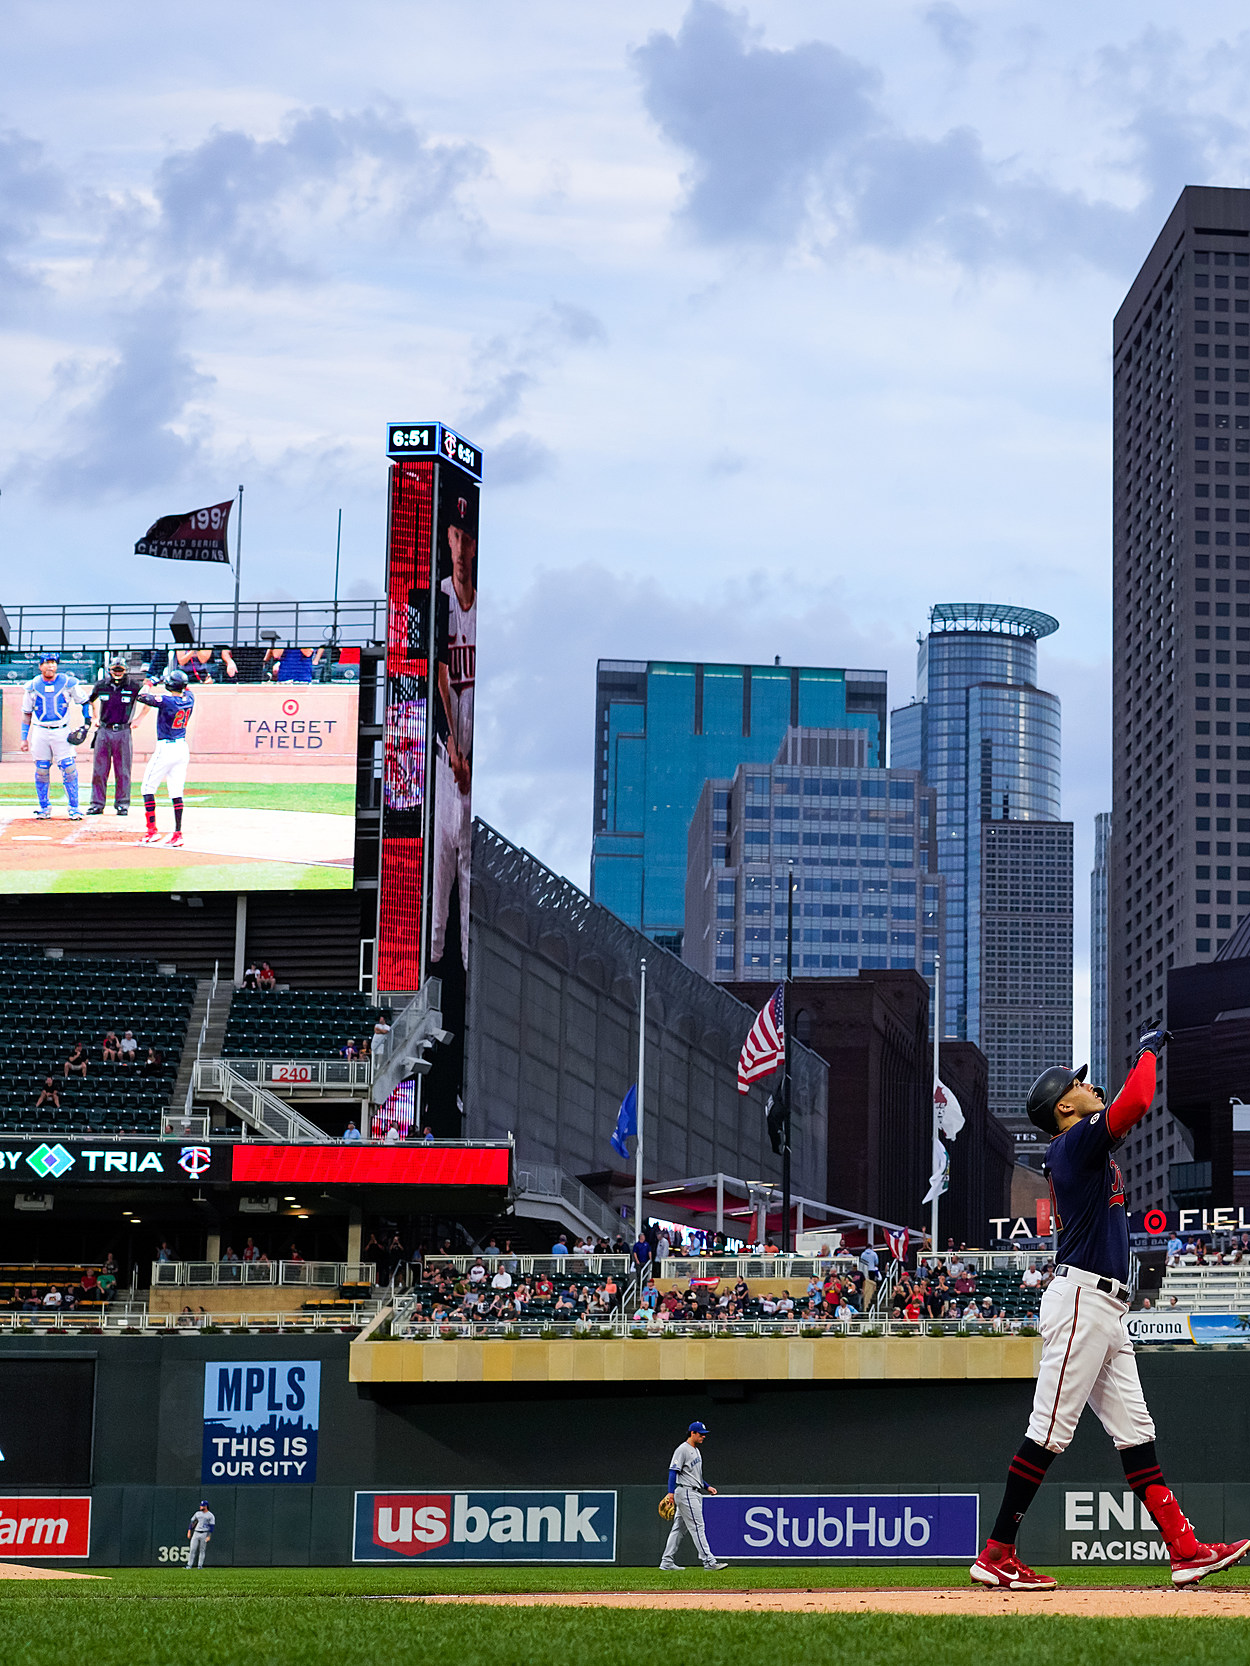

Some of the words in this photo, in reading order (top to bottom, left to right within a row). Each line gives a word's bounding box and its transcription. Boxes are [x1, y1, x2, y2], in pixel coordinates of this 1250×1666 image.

[393, 430, 429, 447] 6:51
[457, 443, 475, 467] 6:51
[137, 543, 225, 561] CHAMPIONS
[244, 720, 337, 733] TARGET
[255, 736, 323, 749] FIELD
[280, 1066, 309, 1082] 240
[1012, 1133, 1037, 1141] TES
[81, 1151, 164, 1172] TRIA
[1149, 1238, 1169, 1246] BAN
[1127, 1319, 1183, 1339] Corona
[217, 1367, 305, 1412] MPLS
[212, 1437, 275, 1457] THIS
[283, 1437, 308, 1457] IS
[211, 1462, 254, 1477] OUR
[259, 1461, 308, 1476] CITY
[0, 1511, 69, 1545] arm
[744, 1506, 931, 1548] StubHub
[158, 1546, 190, 1562] 365
[1071, 1541, 1170, 1560] RACISM
